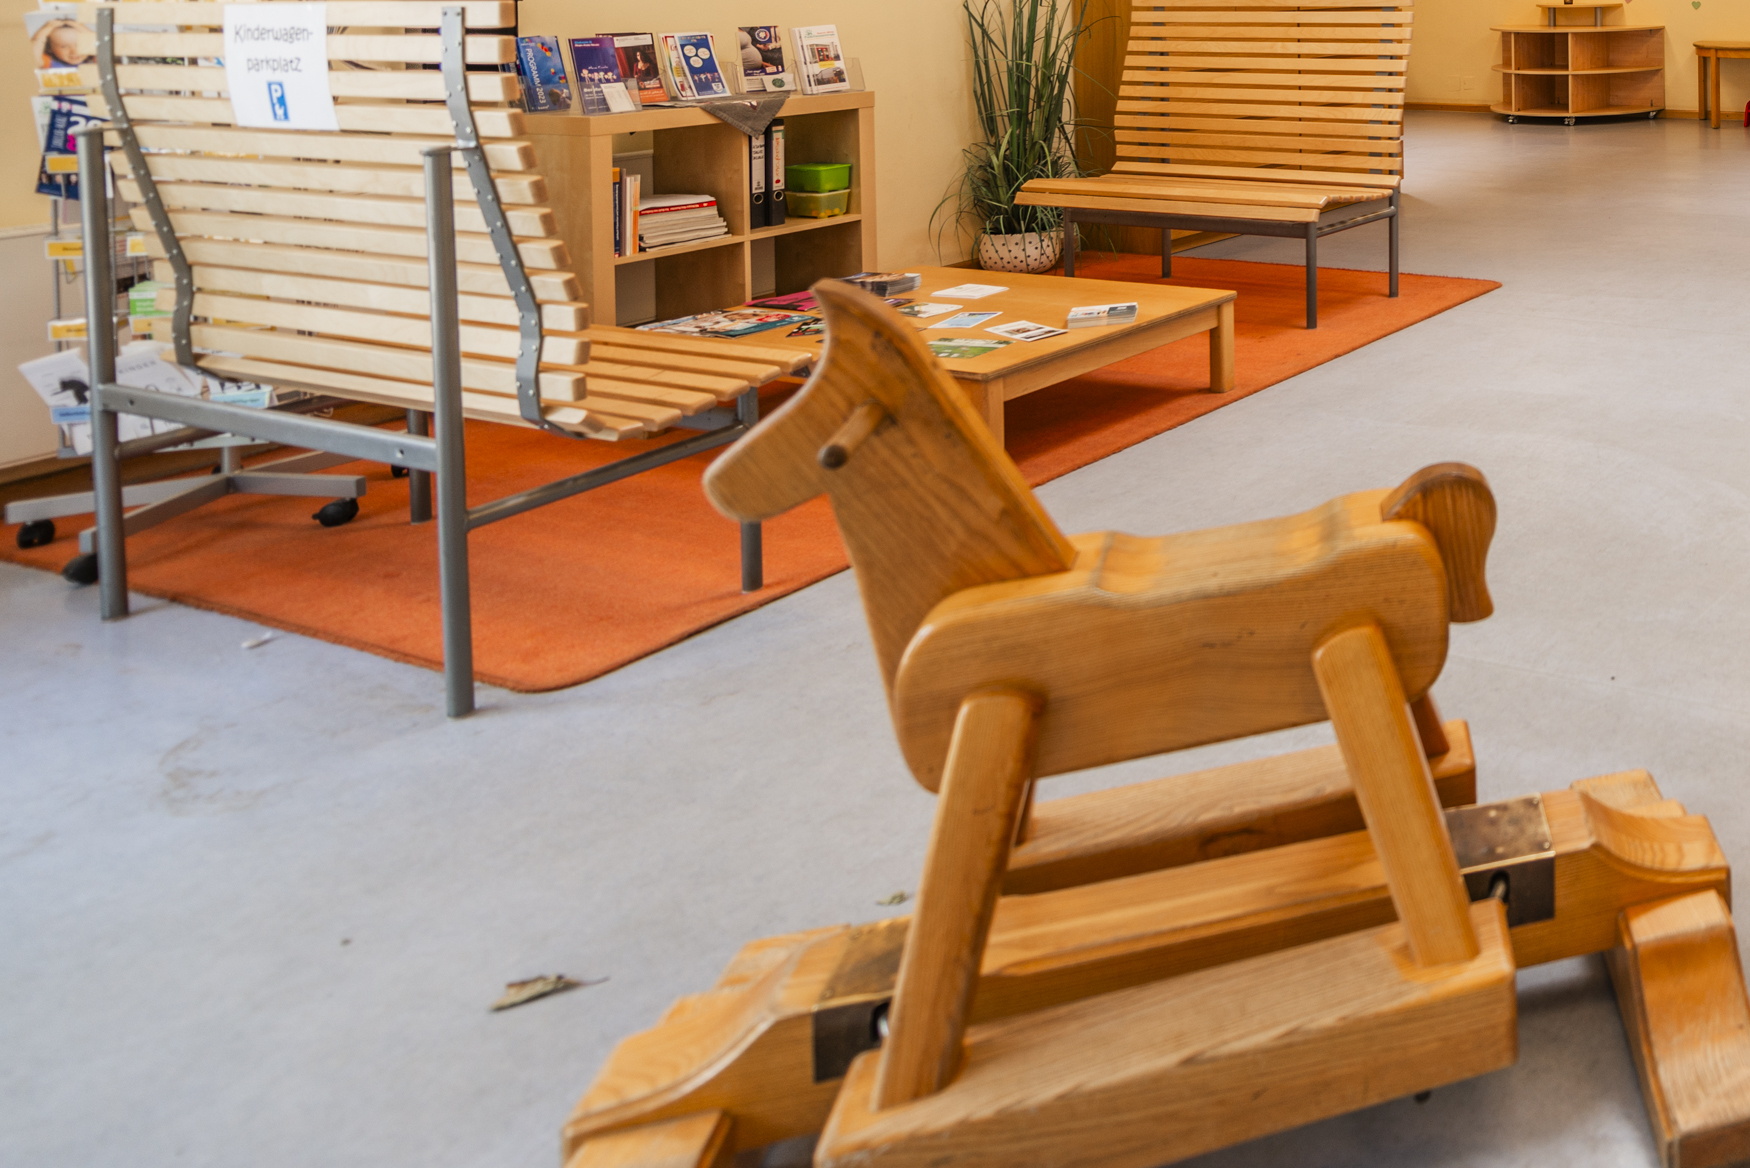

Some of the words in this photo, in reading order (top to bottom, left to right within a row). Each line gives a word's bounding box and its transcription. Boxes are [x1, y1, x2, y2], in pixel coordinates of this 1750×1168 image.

[234, 24, 313, 44] Kinderwagen-
[247, 56, 302, 73] parkplatz
[525, 48, 542, 87] PROGRAMM
[536, 87, 547, 104] 2023
